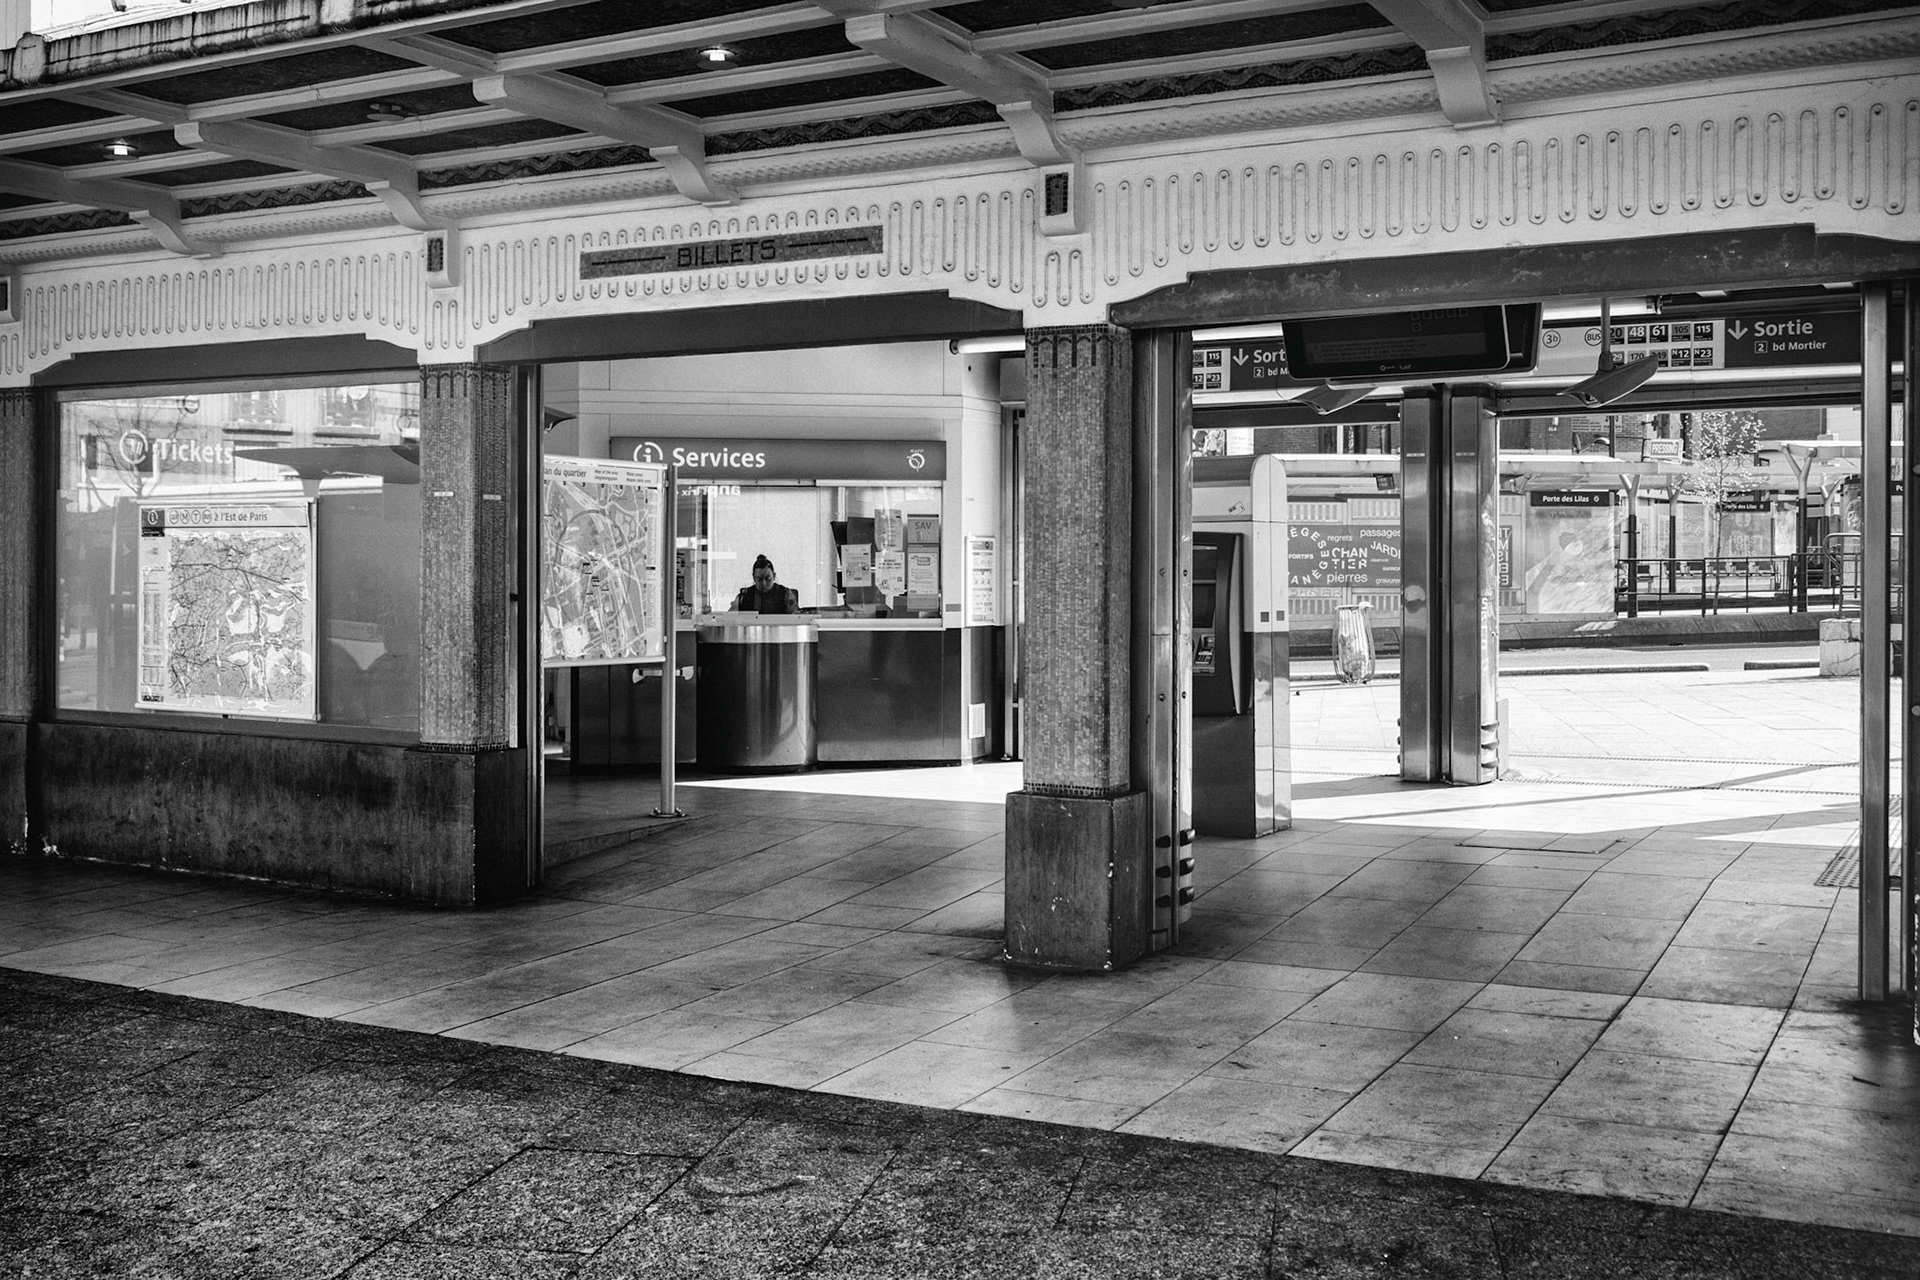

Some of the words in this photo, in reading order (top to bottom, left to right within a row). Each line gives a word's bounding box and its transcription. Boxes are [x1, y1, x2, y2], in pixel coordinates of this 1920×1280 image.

[677, 239, 776, 267] BILLETS
[1629, 326, 1645, 337] 48
[1652, 325, 1666, 335] 61
[1673, 326, 1689, 334] 105
[1696, 324, 1711, 333] 115
[1754, 319, 1814, 337] Sortie
[1546, 333, 1559, 344] 3b
[1757, 343, 1765, 352] 2
[1772, 342, 1786, 351] bd
[1788, 341, 1827, 350] Mortier
[1193, 353, 1204, 361] 05
[1208, 352, 1220, 360] 115
[1253, 349, 1286, 363] Sort
[1610, 353, 1623, 362] 29
[1630, 353, 1645, 361] 170
[1672, 349, 1690, 359] N12
[1694, 348, 1712, 358] N23
[1267, 368, 1278, 376] bd
[156, 438, 233, 464] Tickets
[1652, 443, 1678, 454] PRESSING
[672, 447, 766, 468] Services
[543, 467, 553, 475] an
[554, 467, 562, 476] du
[563, 469, 587, 478] quartier
[1542, 495, 1560, 503] Porte
[1561, 495, 1573, 503] des
[1574, 495, 1589, 503] Lilas
[220, 512, 237, 521] l'Est
[238, 511, 248, 521] de
[249, 512, 268, 521] Paris
[914, 521, 932, 530] SAV
[1327, 535, 1353, 543] regrets
[1331, 547, 1368, 558] CHAN
[1370, 541, 1400, 560] JARDI
[1331, 558, 1368, 570] TIER
[1326, 571, 1368, 584] pierres
